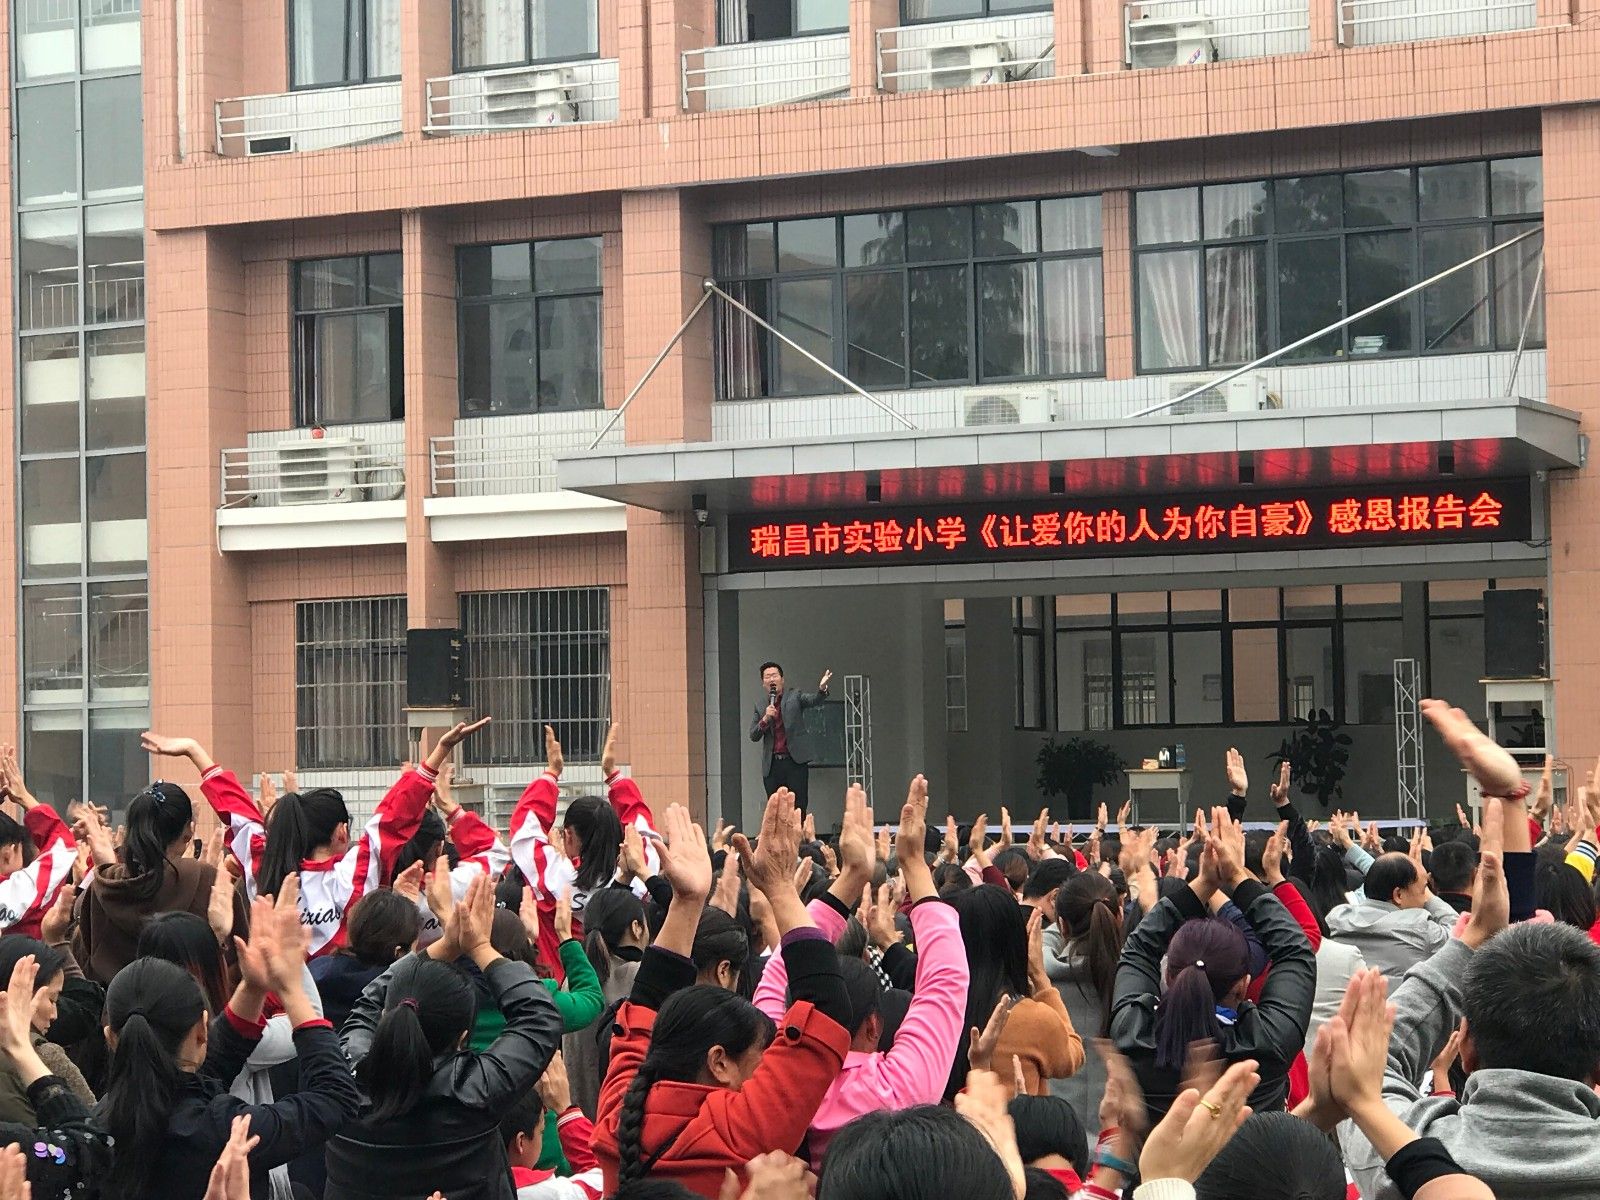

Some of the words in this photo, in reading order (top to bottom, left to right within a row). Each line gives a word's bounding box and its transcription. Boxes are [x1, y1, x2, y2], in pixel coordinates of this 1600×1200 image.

[751, 493, 1502, 557] 瑞昌市实验小学《让爱你的人为你自豪》感恩报告会
